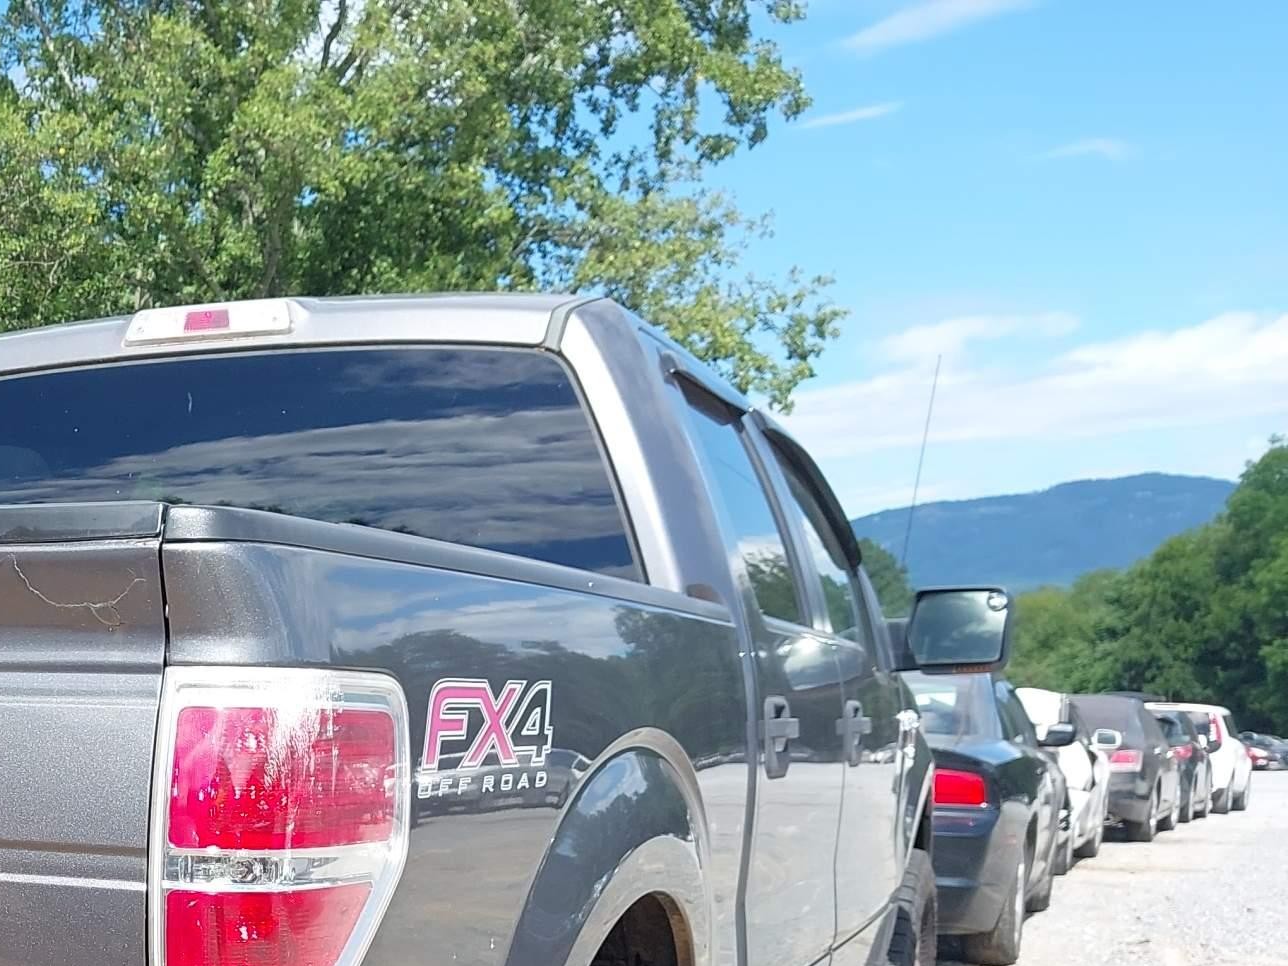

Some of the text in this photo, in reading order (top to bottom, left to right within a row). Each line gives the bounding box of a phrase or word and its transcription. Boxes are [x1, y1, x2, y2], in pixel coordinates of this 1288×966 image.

[420, 677, 553, 773] FX4
[417, 771, 547, 799] OFF ROAD
